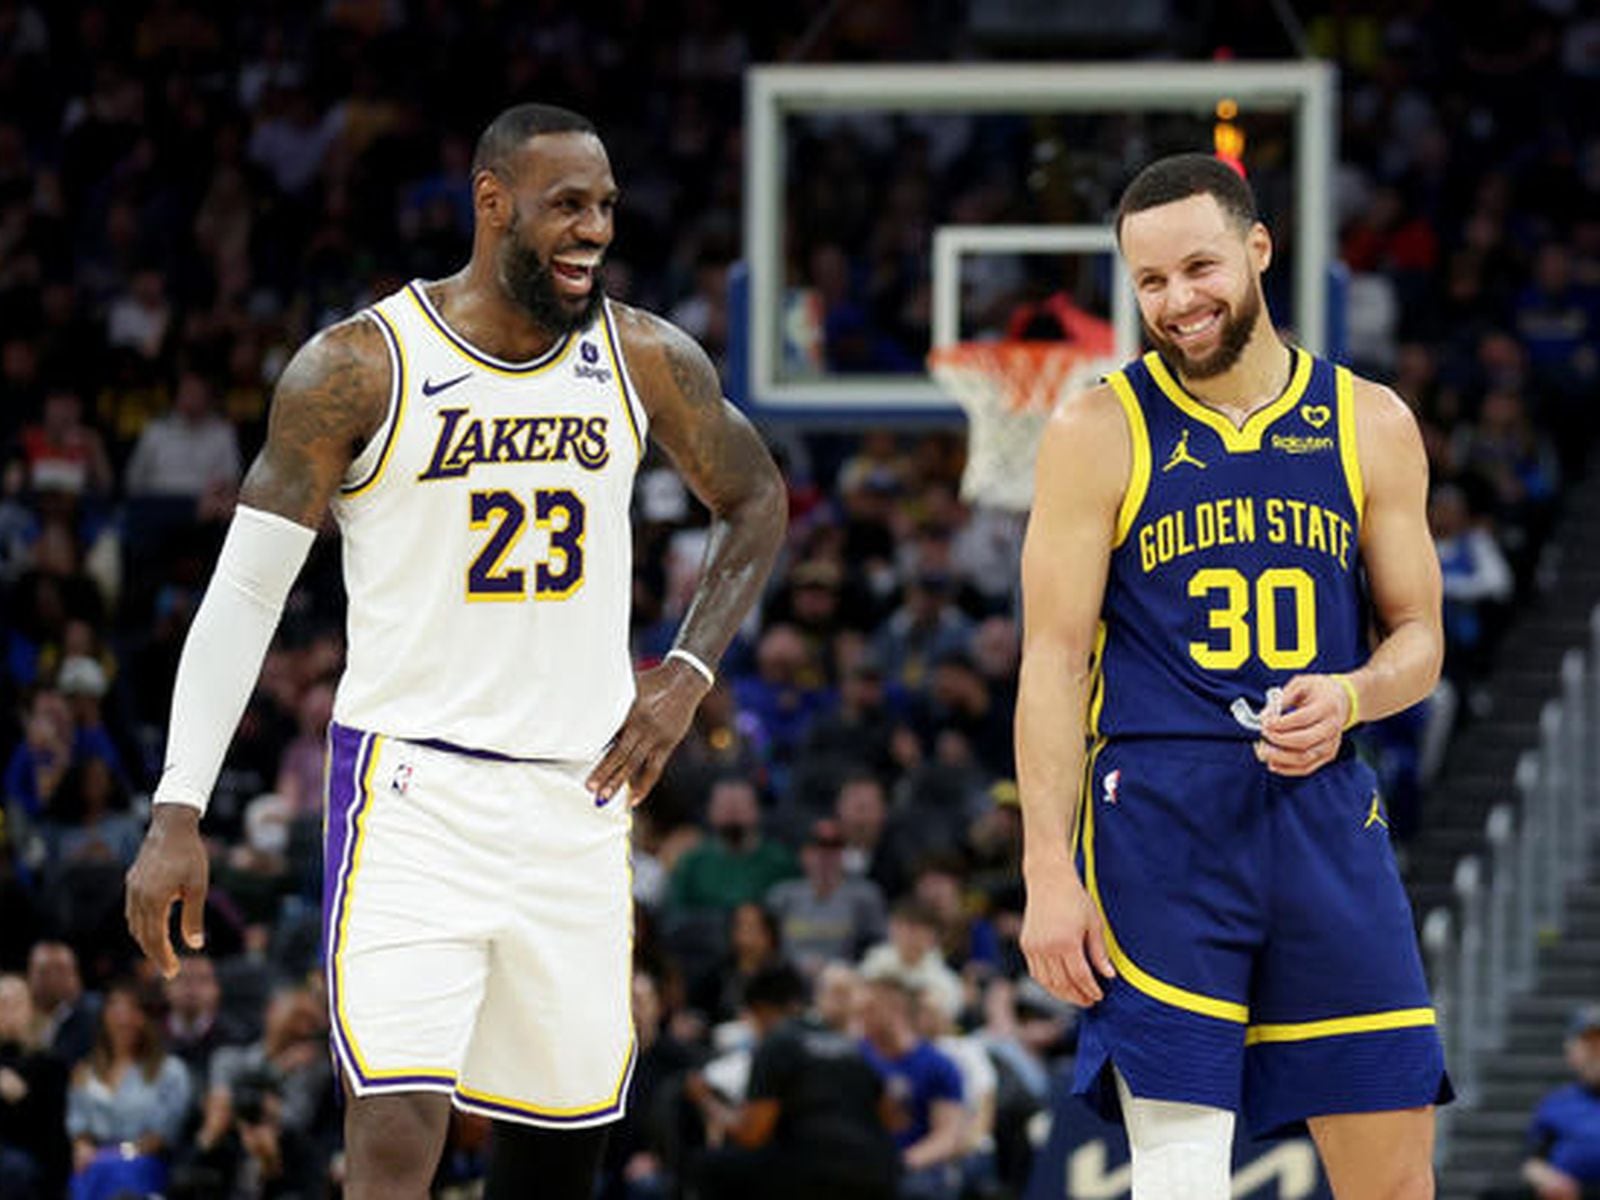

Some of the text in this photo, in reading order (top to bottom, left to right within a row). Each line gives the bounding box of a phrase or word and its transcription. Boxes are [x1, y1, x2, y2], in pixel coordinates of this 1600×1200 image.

[417, 407, 609, 482] LAKERS
[465, 488, 586, 602] 23
[1139, 498, 1352, 573] GOLDEN STATE
[1188, 568, 1317, 670] 30
